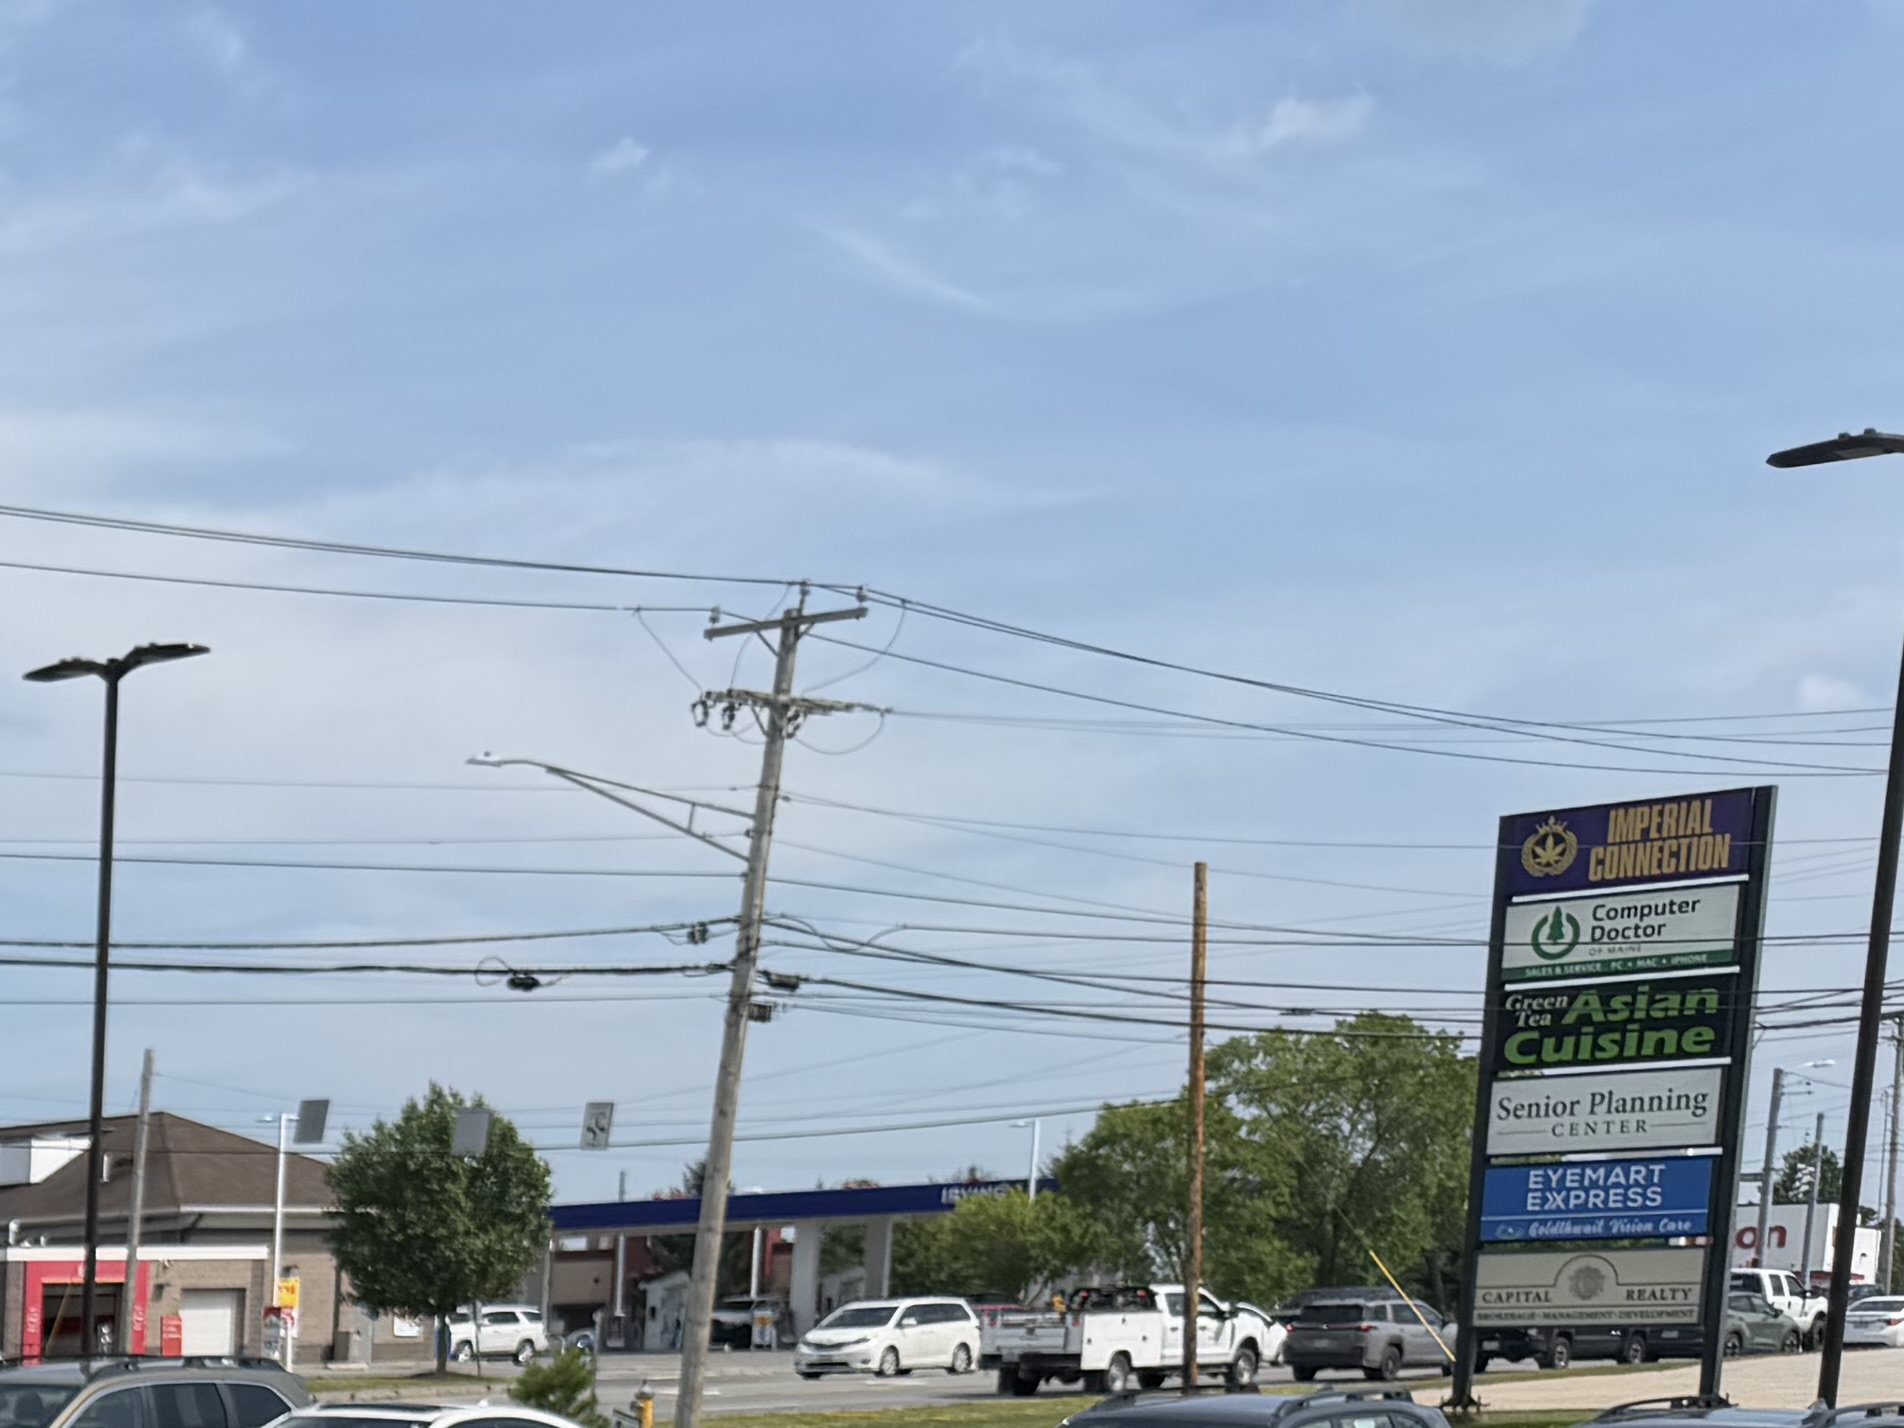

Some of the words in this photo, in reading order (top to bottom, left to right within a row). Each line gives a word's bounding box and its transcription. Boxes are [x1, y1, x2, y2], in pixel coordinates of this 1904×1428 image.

[1607, 799, 1713, 844] IMPERIAL
[1588, 833, 1731, 881] CONNECTION
[1592, 898, 1701, 922] Computer
[1590, 923, 1667, 942] Doctor
[1505, 994, 1569, 1012] Green
[1561, 985, 1720, 1025] Asian
[1515, 1010, 1552, 1027] Tea
[1503, 1023, 1716, 1065] Cuisine
[1496, 1095, 1580, 1121] Senior
[1588, 1088, 1709, 1118] Planning
[1551, 1119, 1648, 1137] CENTER
[1528, 1164, 1667, 1190] EYEMART
[1526, 1186, 1663, 1211] EXPRESS
[1609, 1218, 1654, 1234] Vision
[1659, 1217, 1692, 1232] Care
[1481, 1290, 1552, 1304] CAPITAL
[1626, 1287, 1693, 1301] REALTY
[1543, 1310, 1613, 1321] MANAGEMENT
[1617, 1309, 1695, 1320] DEVELOPMENT
